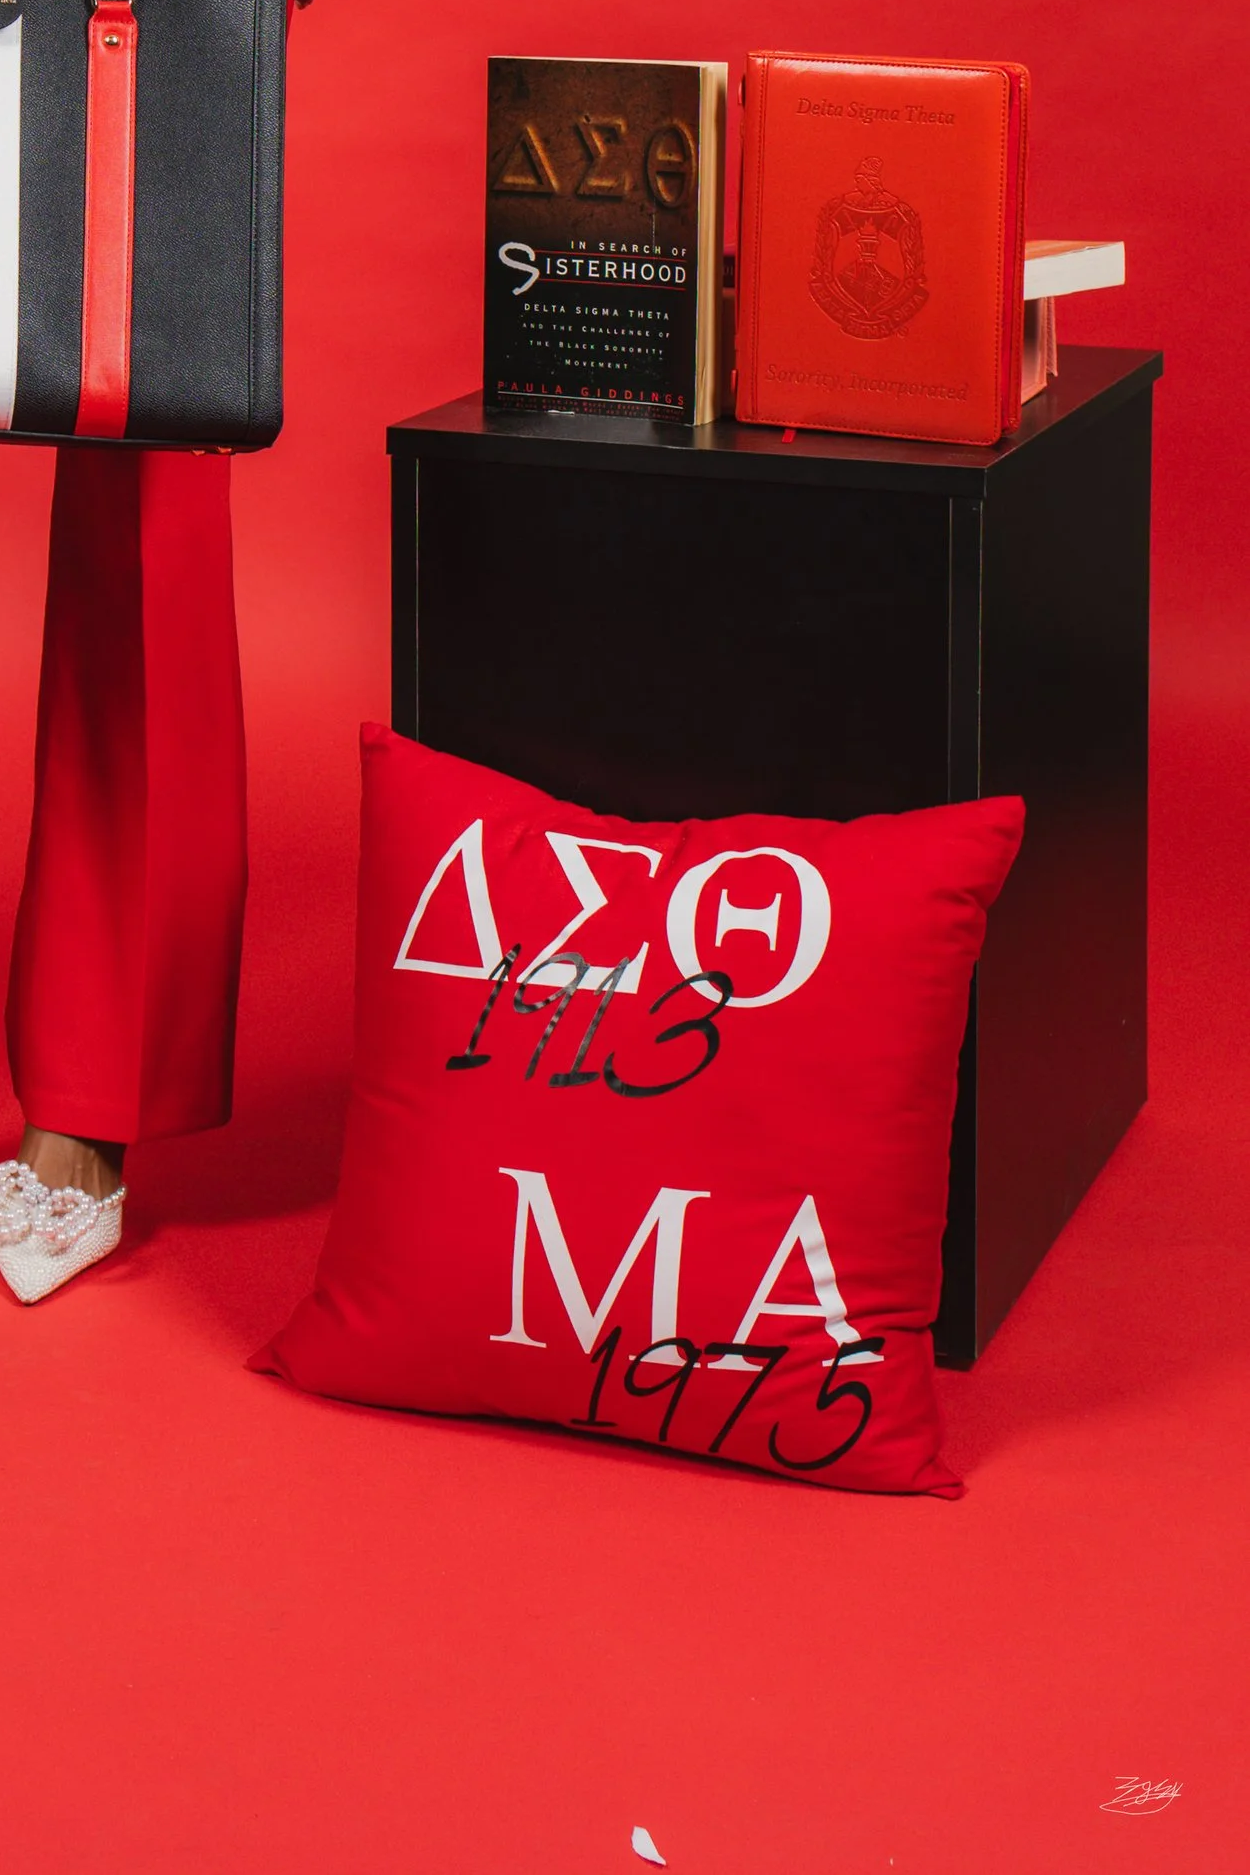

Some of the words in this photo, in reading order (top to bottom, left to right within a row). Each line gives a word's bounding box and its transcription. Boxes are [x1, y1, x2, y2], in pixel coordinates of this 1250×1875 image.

[796, 98, 844, 117] Delta
[847, 101, 899, 125] Sigma
[905, 105, 955, 125] Theta
[570, 240, 587, 250] IN
[599, 242, 662, 254] SEARCH
[671, 248, 687, 257] OF
[498, 241, 687, 296] SISTERHOOD
[524, 303, 566, 313] DELTA
[575, 306, 619, 317] SIGMA
[628, 309, 670, 321] THETA
[553, 324, 573, 332] THE
[497, 381, 563, 394] PAULA
[580, 386, 684, 405] GIDDINGS
[765, 364, 844, 392] Sorority,
[848, 372, 969, 402] Incorporated
[445, 943, 735, 1098] 1913
[568, 1325, 886, 1471] 1975
